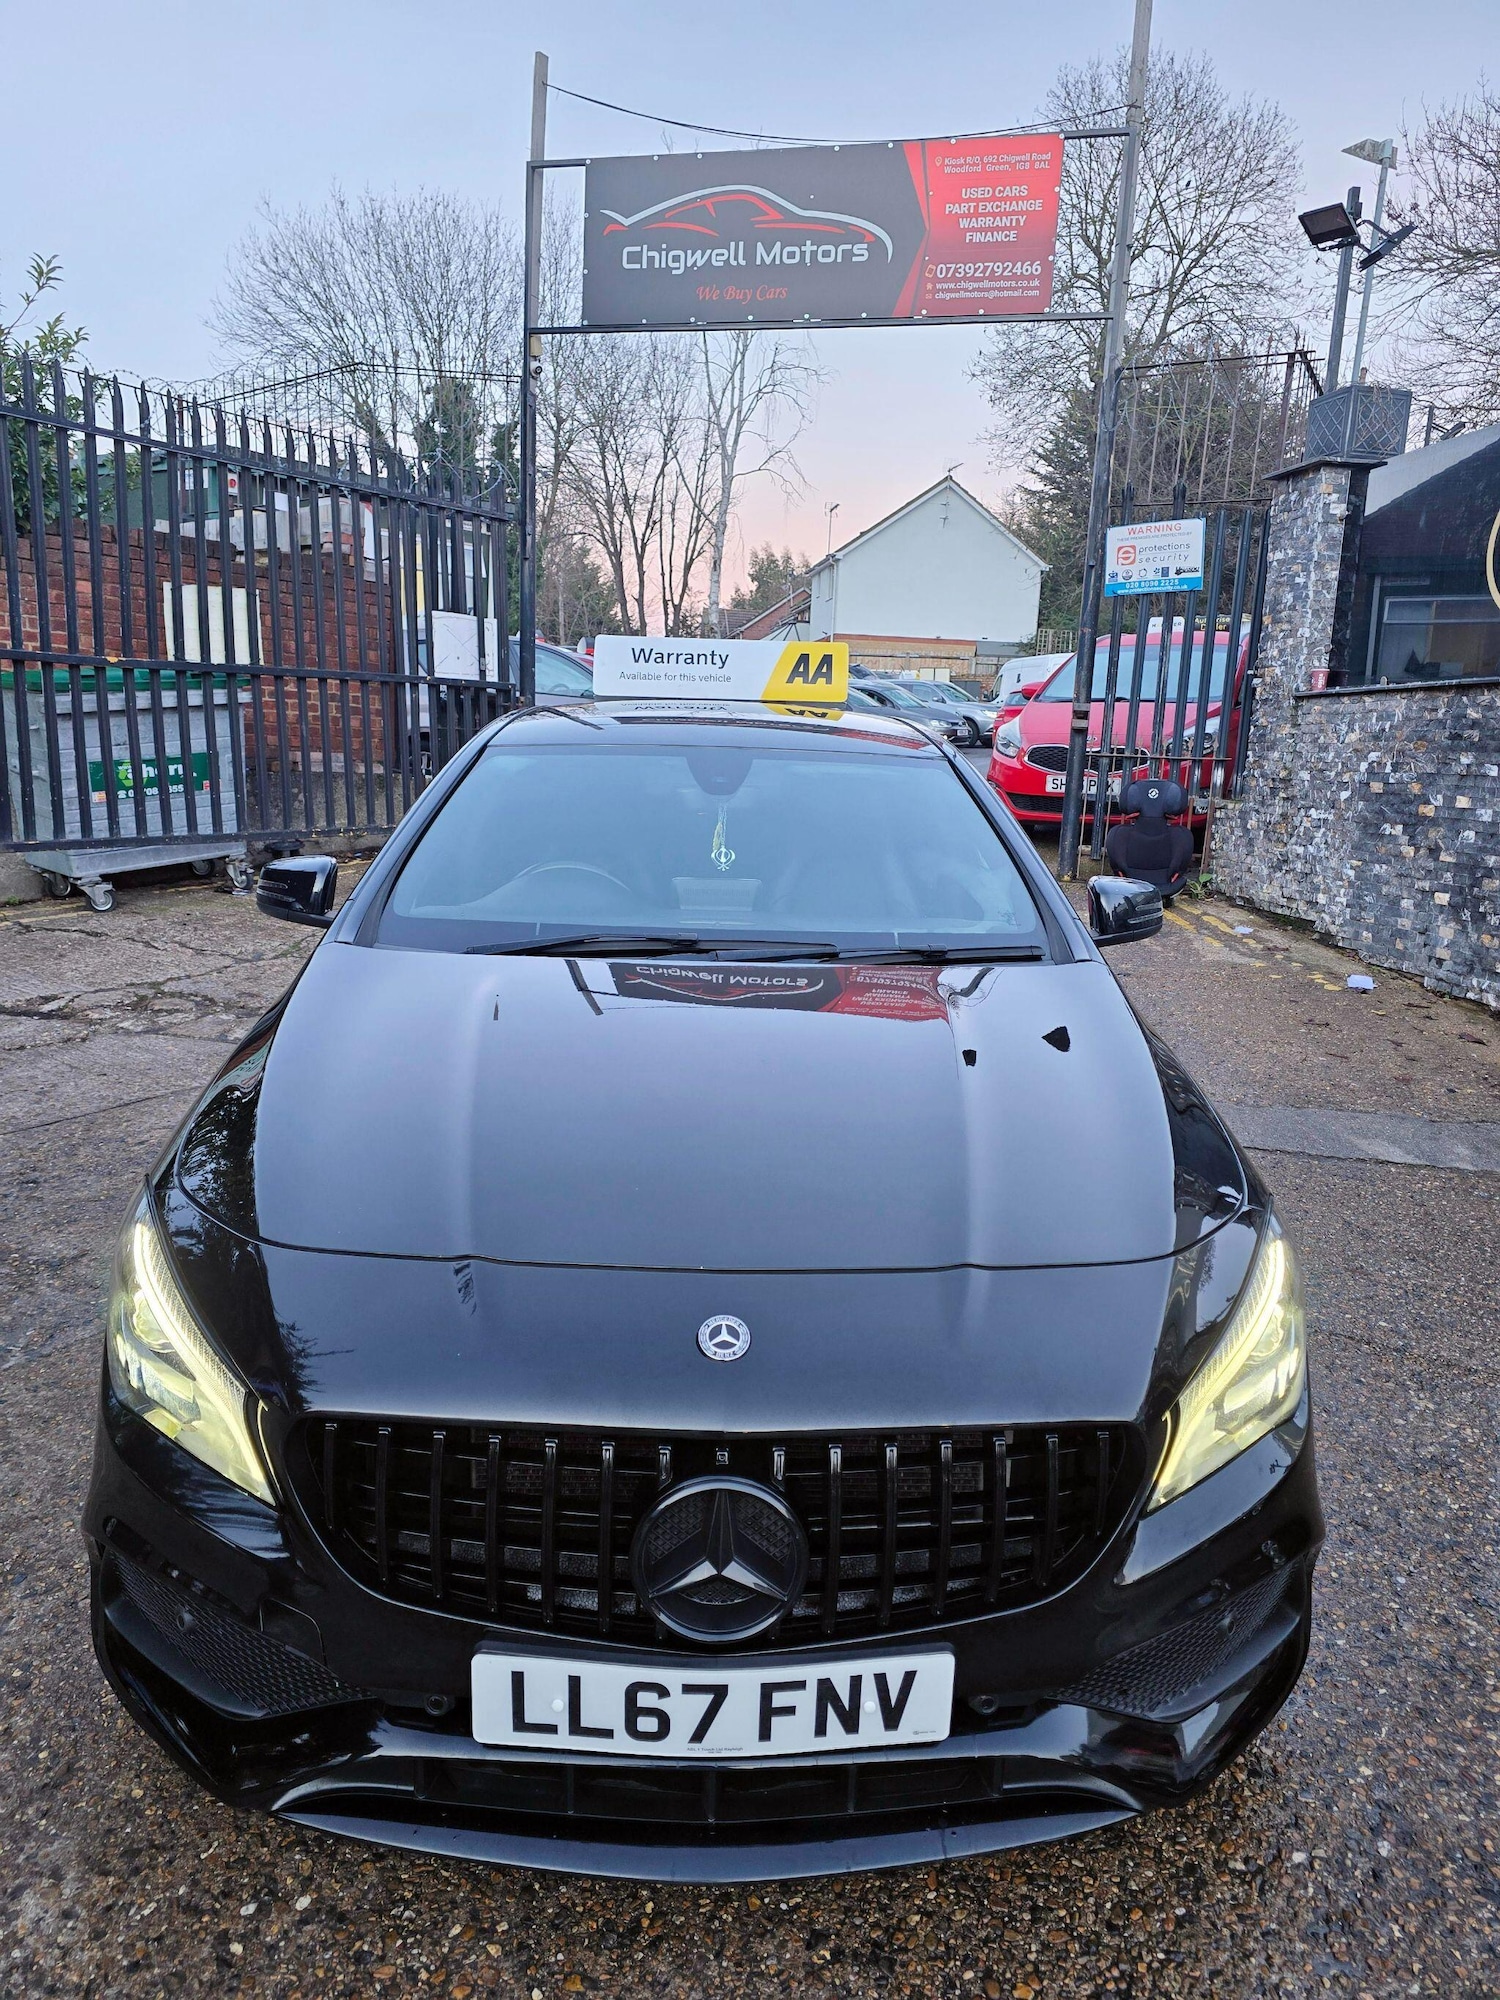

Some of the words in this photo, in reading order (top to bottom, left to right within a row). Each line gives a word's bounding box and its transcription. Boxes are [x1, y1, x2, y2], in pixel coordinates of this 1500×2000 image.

[944, 156, 965, 166] Kiosk
[983, 155, 998, 164] 692
[999, 153, 1031, 164] Chigwell
[1031, 151, 1052, 161] Road
[944, 164, 982, 174] Woodford
[986, 163, 1012, 172] Green,
[1016, 162, 1030, 170] IG8
[1034, 161, 1050, 170] 8AL
[961, 187, 993, 199] USED
[995, 185, 1029, 197] CARS
[945, 202, 977, 215] PART
[978, 199, 1044, 213] EXCHANGE
[959, 215, 1027, 229] WARRANTY
[965, 230, 1018, 243] FINANCE
[622, 240, 747, 275] Chigwell
[755, 239, 869, 266] Motors
[936, 260, 1042, 278] 07392792466
[935, 278, 1041, 290] www.chigwellmotors.co.uk
[696, 283, 720, 301] We
[723, 285, 753, 305] Buy
[756, 284, 788, 301] Cars
[934, 289, 1040, 301] chigwellmotors@hotmail.com
[1127, 522, 1182, 536] WARNING
[1138, 541, 1191, 554] protections
[1138, 552, 1190, 564] security
[1160, 578, 1179, 587] 2225
[631, 647, 729, 670] Warranty
[785, 653, 833, 686] AA
[619, 671, 662, 681] Available
[664, 672, 678, 681] for
[679, 672, 697, 682] this
[698, 673, 732, 683] vehicle
[511, 1670, 730, 1744] LL67
[757, 1670, 918, 1743] FNV
